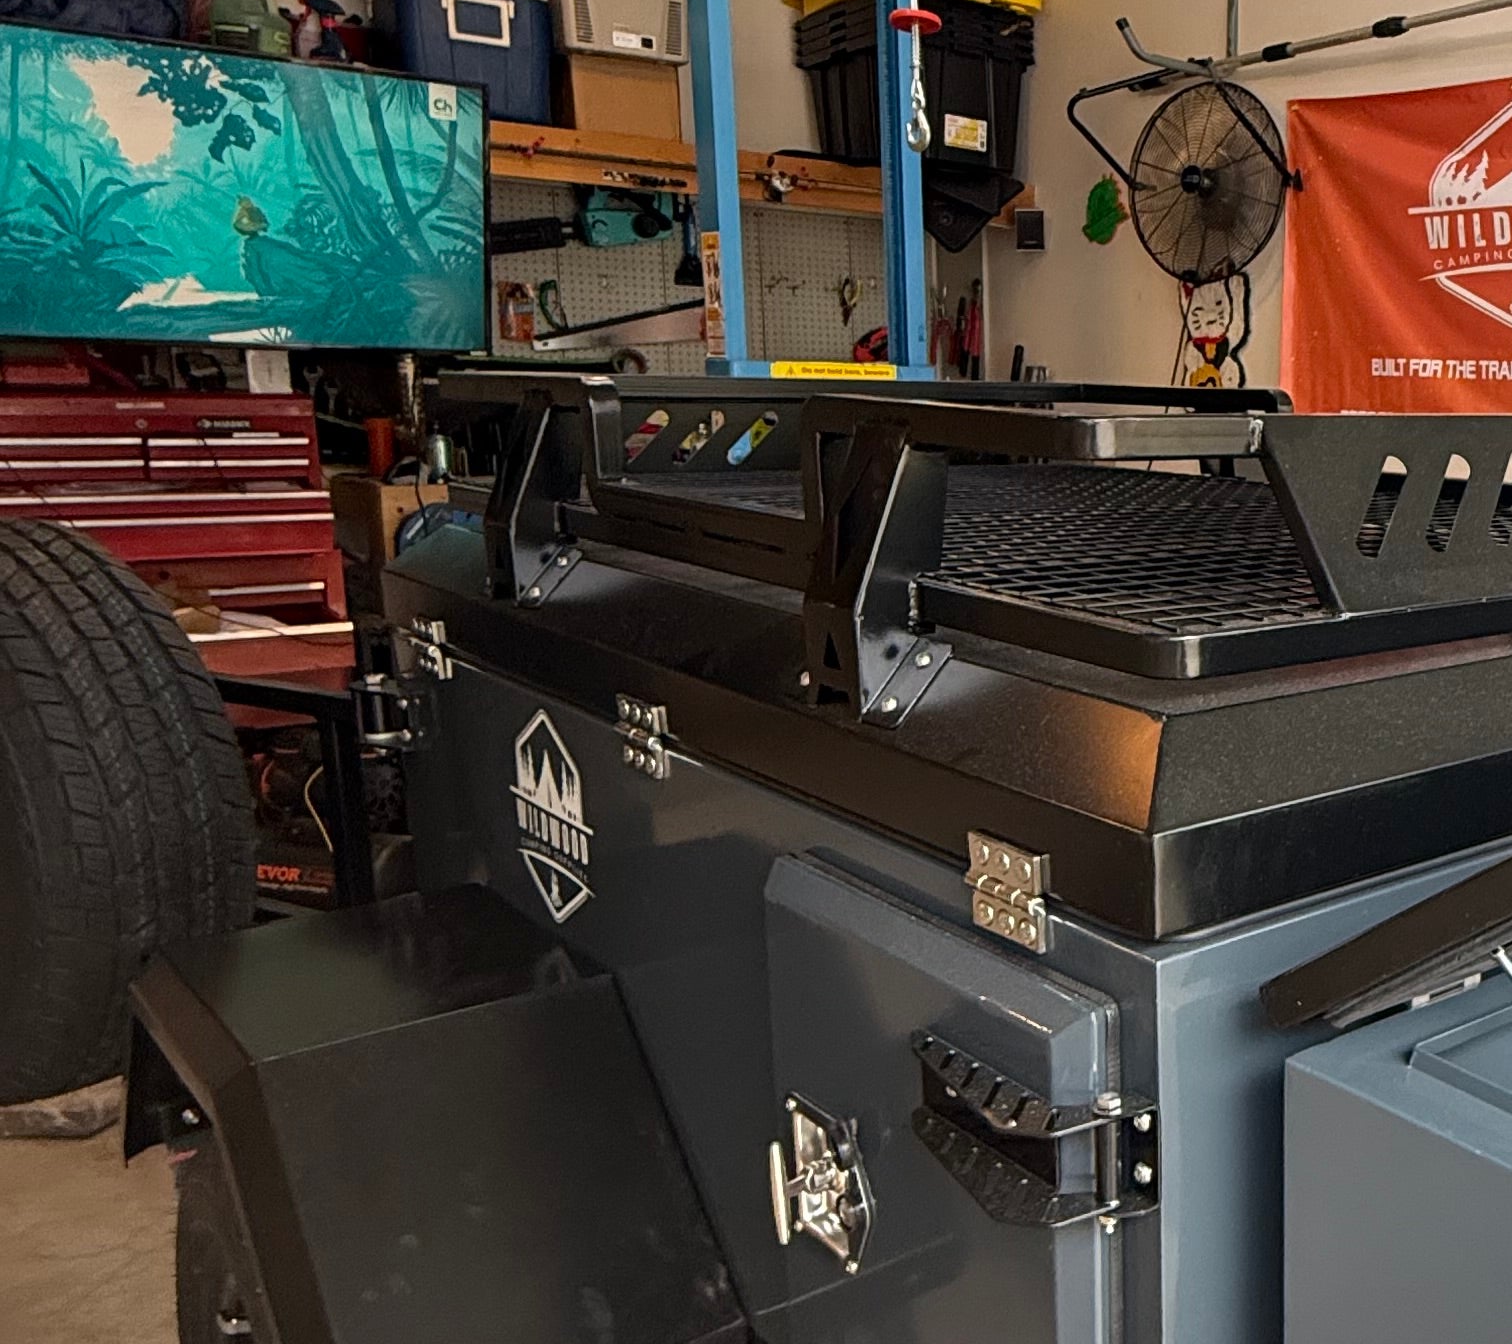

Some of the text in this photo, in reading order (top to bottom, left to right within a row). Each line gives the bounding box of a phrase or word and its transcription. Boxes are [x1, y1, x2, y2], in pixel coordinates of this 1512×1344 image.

[433, 98, 453, 114] Ch
[1371, 358, 1407, 377] BUILT
[1409, 358, 1443, 379] FOR
[1445, 359, 1477, 380] THE
[257, 864, 300, 882] EVOR
